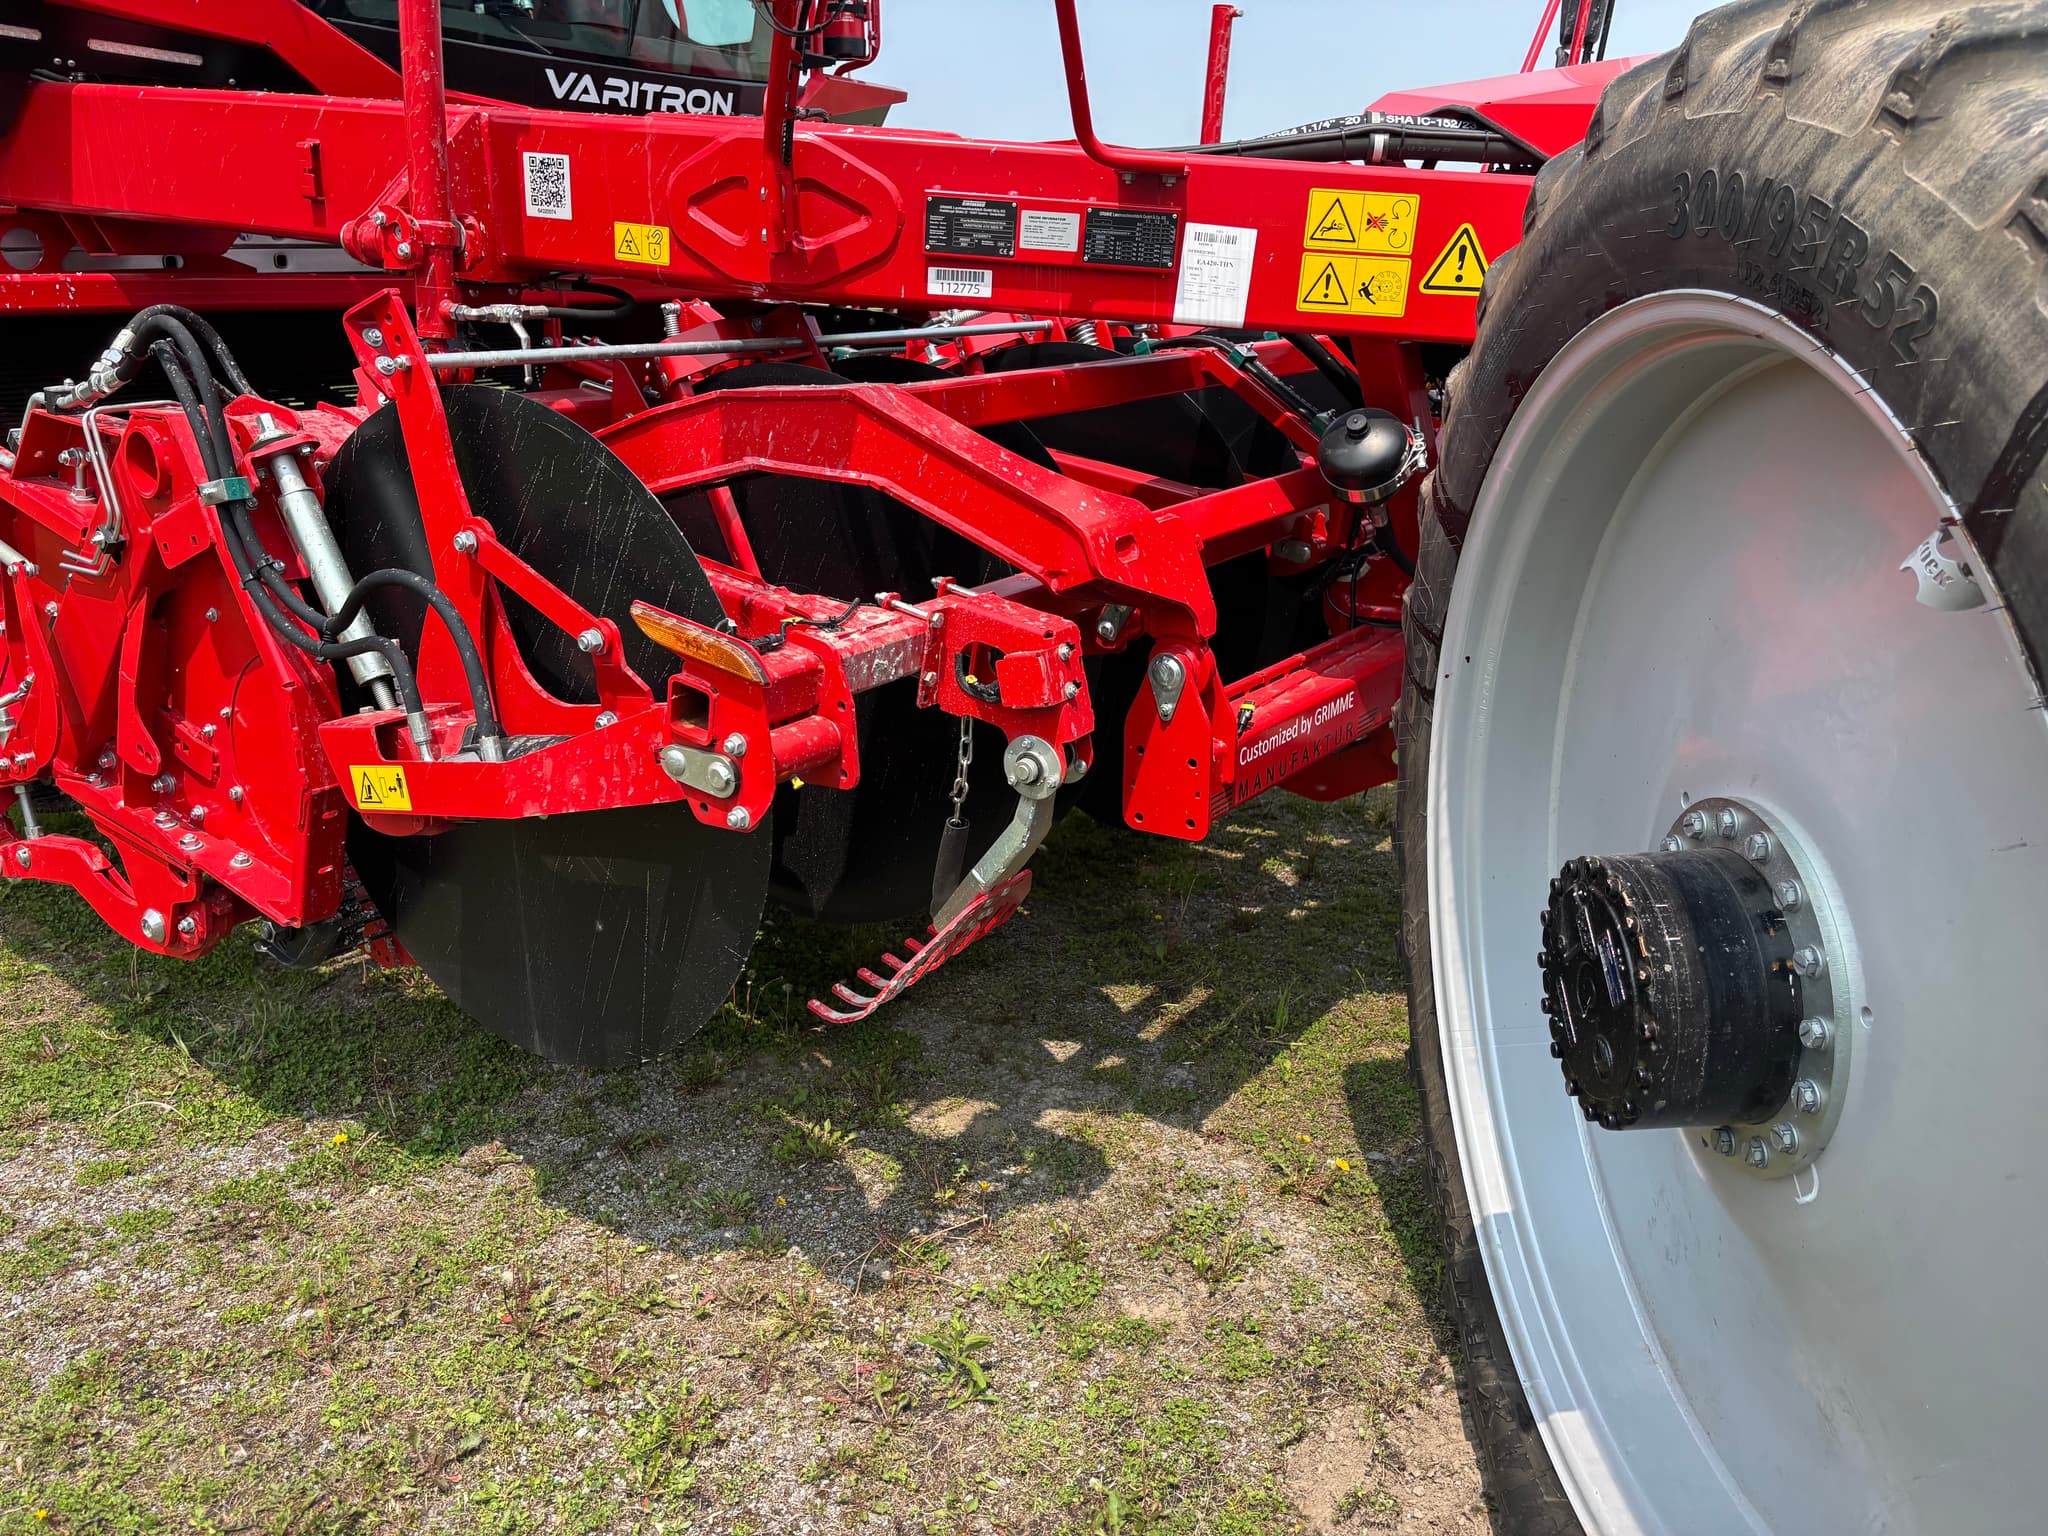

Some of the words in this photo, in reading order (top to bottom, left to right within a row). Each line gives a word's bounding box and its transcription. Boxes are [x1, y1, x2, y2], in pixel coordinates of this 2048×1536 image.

[545, 68, 735, 116] VARITRON
[1386, 115, 1414, 125] SHA
[939, 282, 980, 295] 112775
[1665, 167, 1940, 363] 300/95R52
[1239, 719, 1299, 766] Customized
[1300, 715, 1313, 738] by
[1314, 691, 1355, 727] GRIMME
[1237, 722, 1355, 801] MANUFAKTUR
